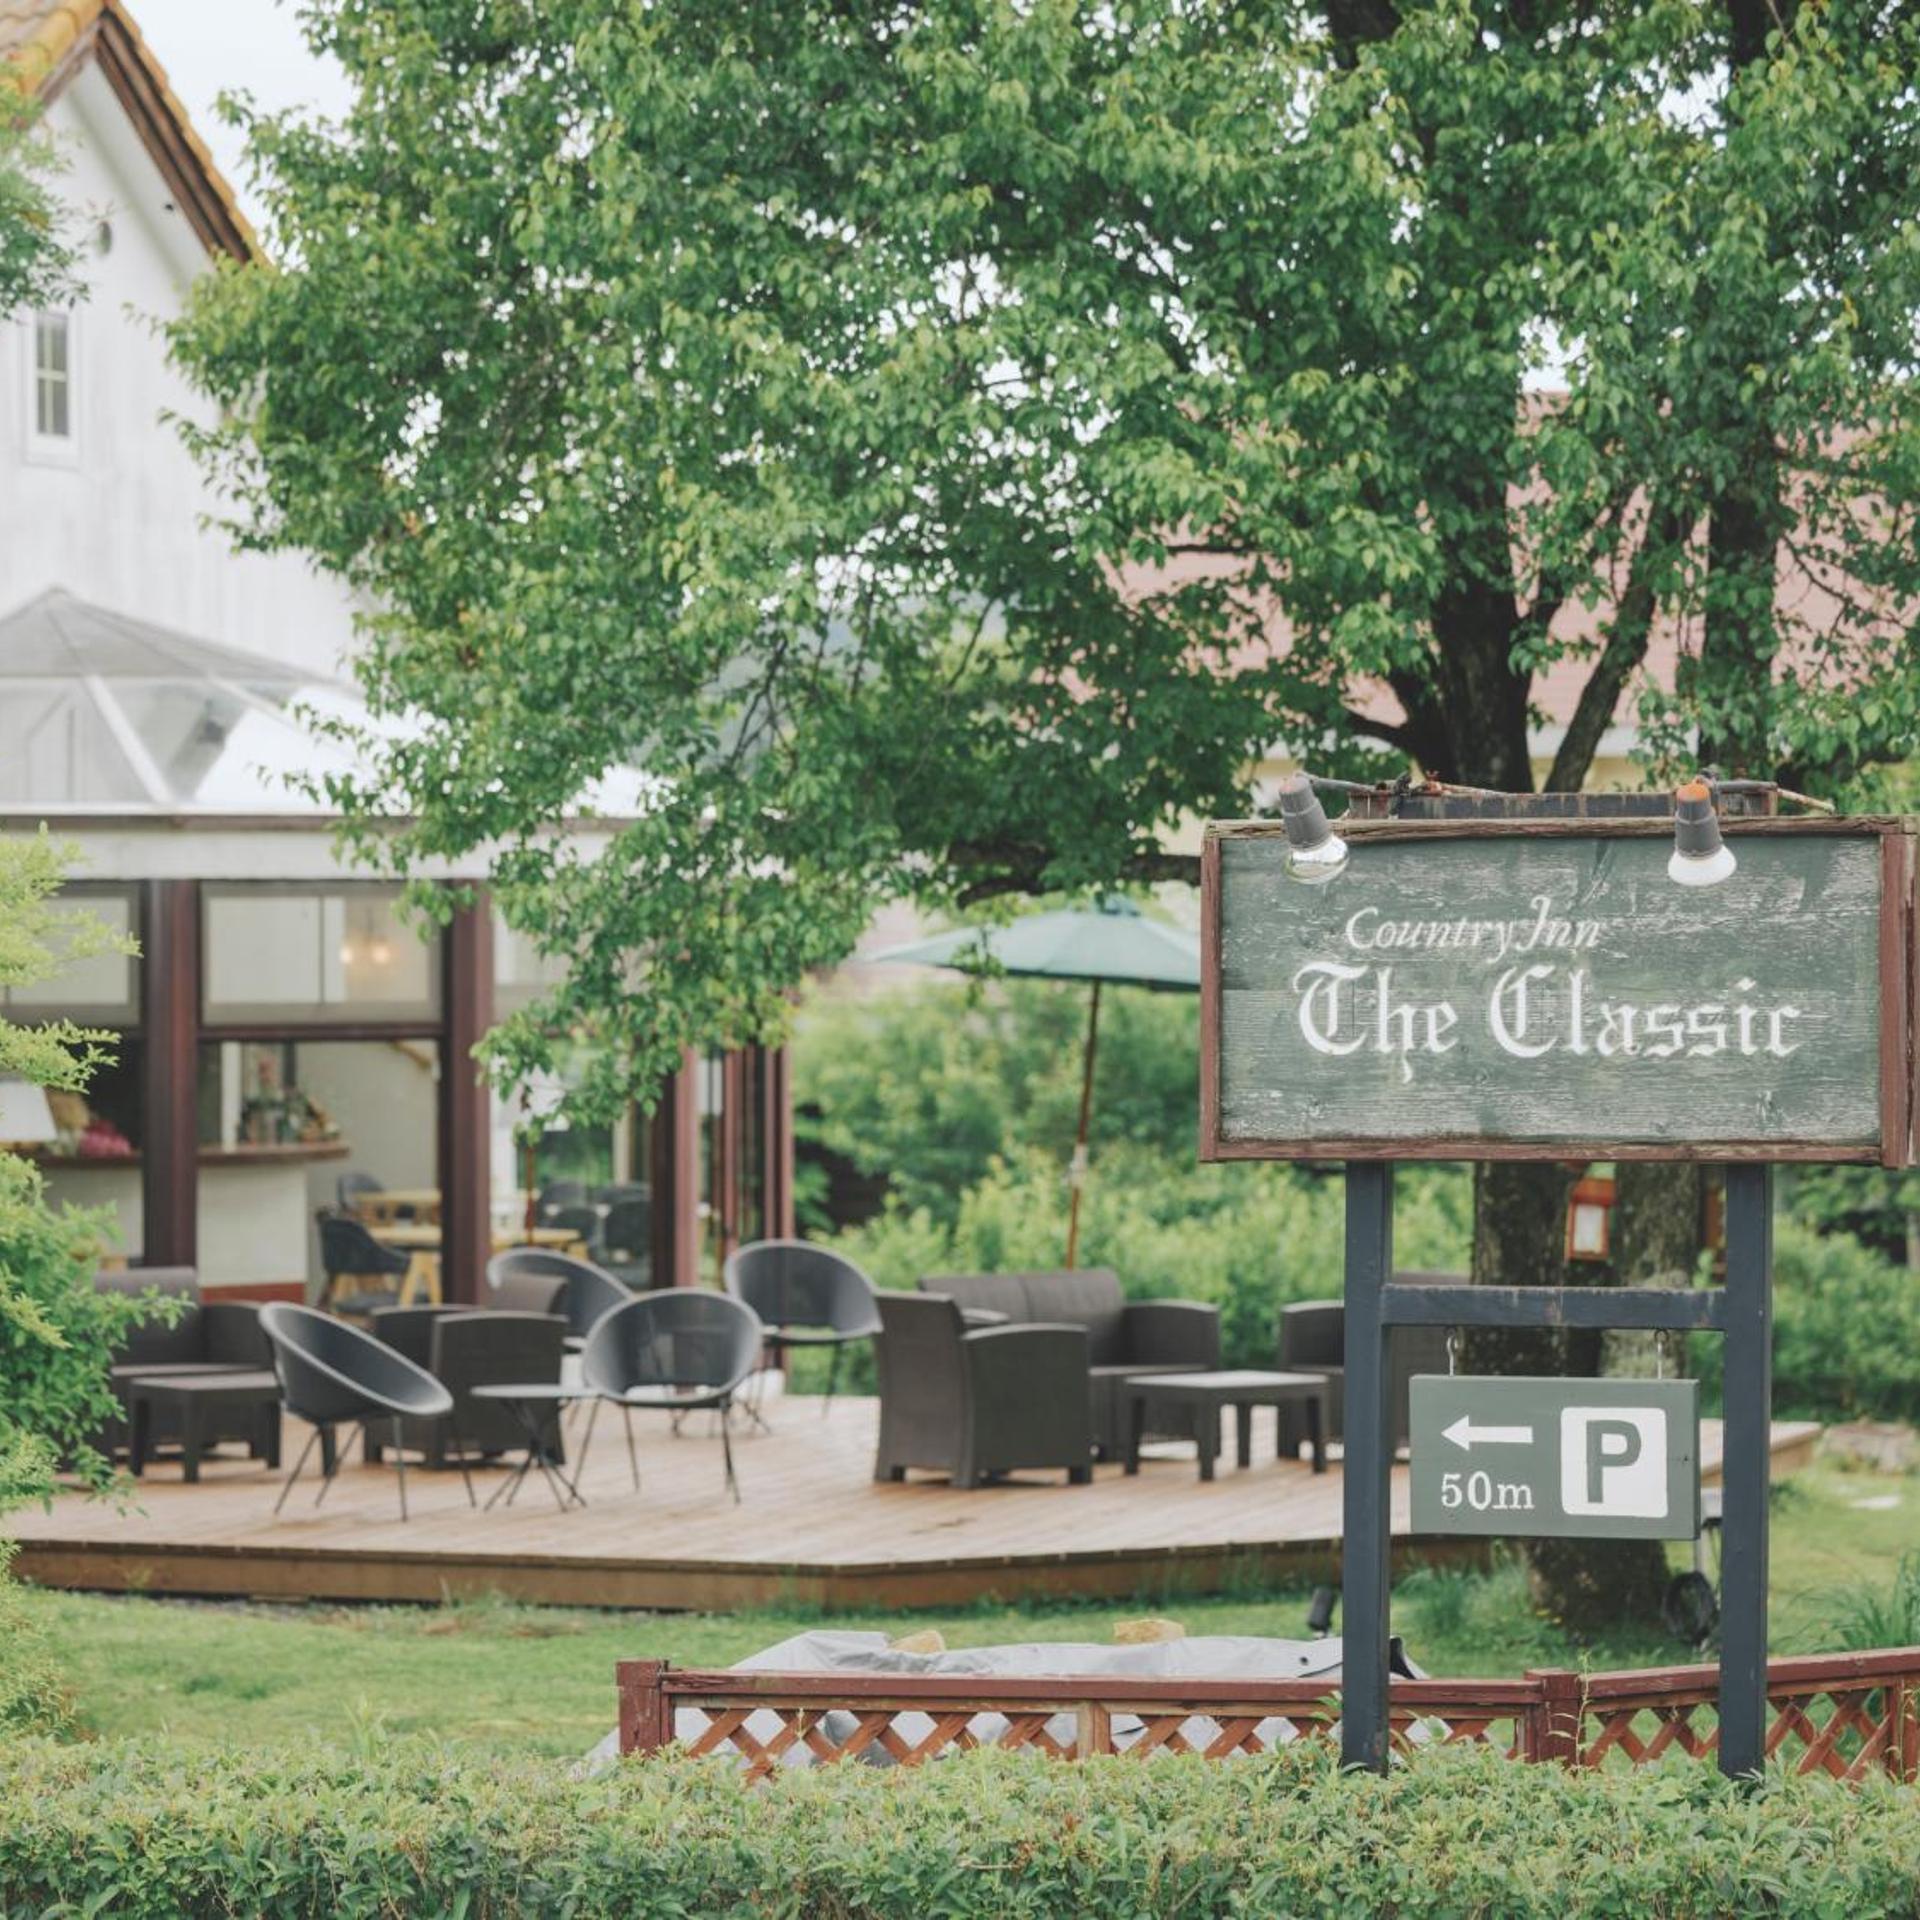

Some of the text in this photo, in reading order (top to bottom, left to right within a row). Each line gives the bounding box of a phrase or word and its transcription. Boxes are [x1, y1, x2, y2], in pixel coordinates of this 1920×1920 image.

[1345, 895, 1602, 964] Country Inn
[1292, 960, 1802, 1085] The Classic
[1440, 1470, 1535, 1511] 50m
[1586, 1419, 1642, 1504] P
